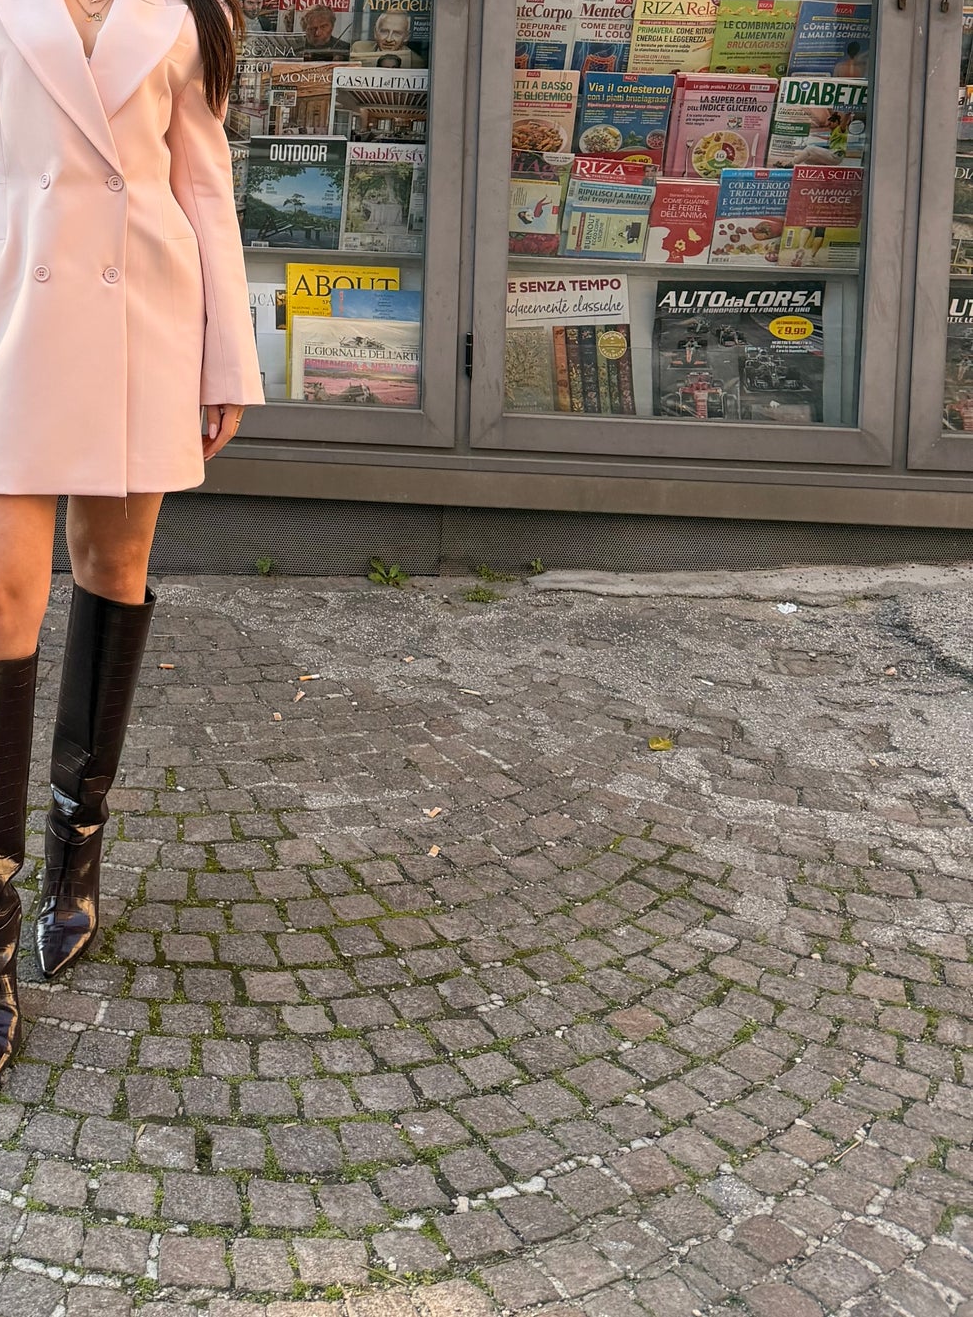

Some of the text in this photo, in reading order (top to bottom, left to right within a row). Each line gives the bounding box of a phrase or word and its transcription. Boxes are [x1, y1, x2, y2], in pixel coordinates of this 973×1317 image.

[520, 22, 567, 31] DEPURARE
[580, 22, 607, 30] COME
[724, 20, 733, 29] LE
[803, 23, 830, 31] COME
[517, 30, 551, 38] COLON
[676, 27, 694, 35] COME
[734, 32, 786, 40] ALIMENTARI
[727, 41, 787, 49] BRUCIAGRASSI
[532, 81, 573, 91] A BASSO
[588, 82, 672, 95] Via il colesterolo
[524, 91, 573, 101] GLICEMICO
[710, 96, 735, 104] SUPER
[736, 96, 758, 104] DIETA
[726, 105, 768, 113] GLICEMICO
[270, 144, 327, 162] OUTDOOR
[352, 146, 402, 162] Shabby
[575, 159, 626, 178] RIZA
[796, 169, 826, 181] RIZA
[728, 181, 790, 190] COLESTEROLO
[578, 188, 613, 198] RIPULISCI
[626, 192, 651, 202] MENTE
[810, 196, 851, 204] VELOCE
[660, 210, 708, 219] DELL'ANIMA
[292, 274, 398, 297] ABOUT
[519, 278, 621, 293] SENZA TEMPO
[572, 295, 625, 313] classiche
[304, 345, 314, 355] IL
[314, 346, 366, 358] GIORNALE
